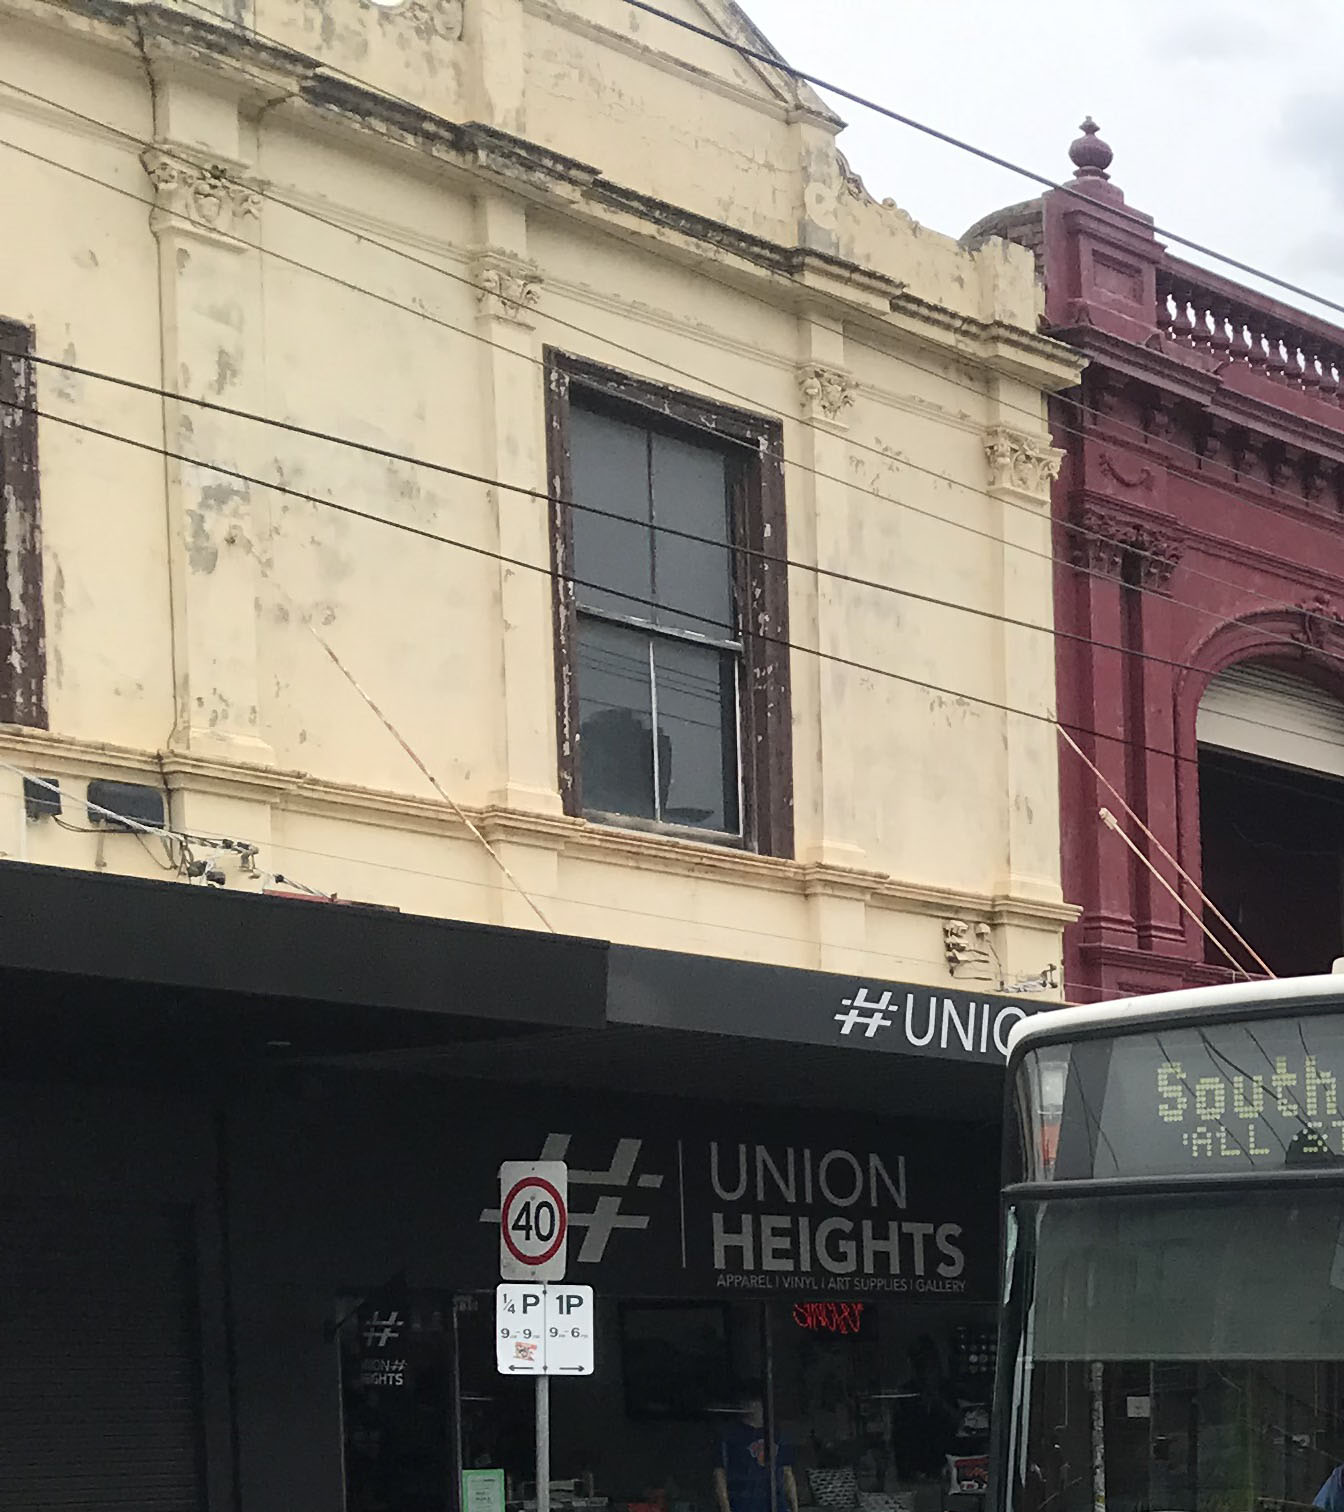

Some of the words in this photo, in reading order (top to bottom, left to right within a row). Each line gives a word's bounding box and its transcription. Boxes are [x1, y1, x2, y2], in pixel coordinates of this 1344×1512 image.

[1157, 1055, 1336, 1122] South
[711, 1141, 906, 1209] UNION
[512, 1200, 556, 1242] 40
[712, 1212, 965, 1278] HEIGHTS
[522, 1293, 541, 1314] P
[717, 1273, 772, 1288] APPAREL
[782, 1275, 818, 1290] VINYL
[828, 1277, 851, 1290] ART
[854, 1277, 907, 1292] SUPPLIES
[916, 1278, 966, 1293] GALLERY
[556, 1294, 584, 1315] 1P
